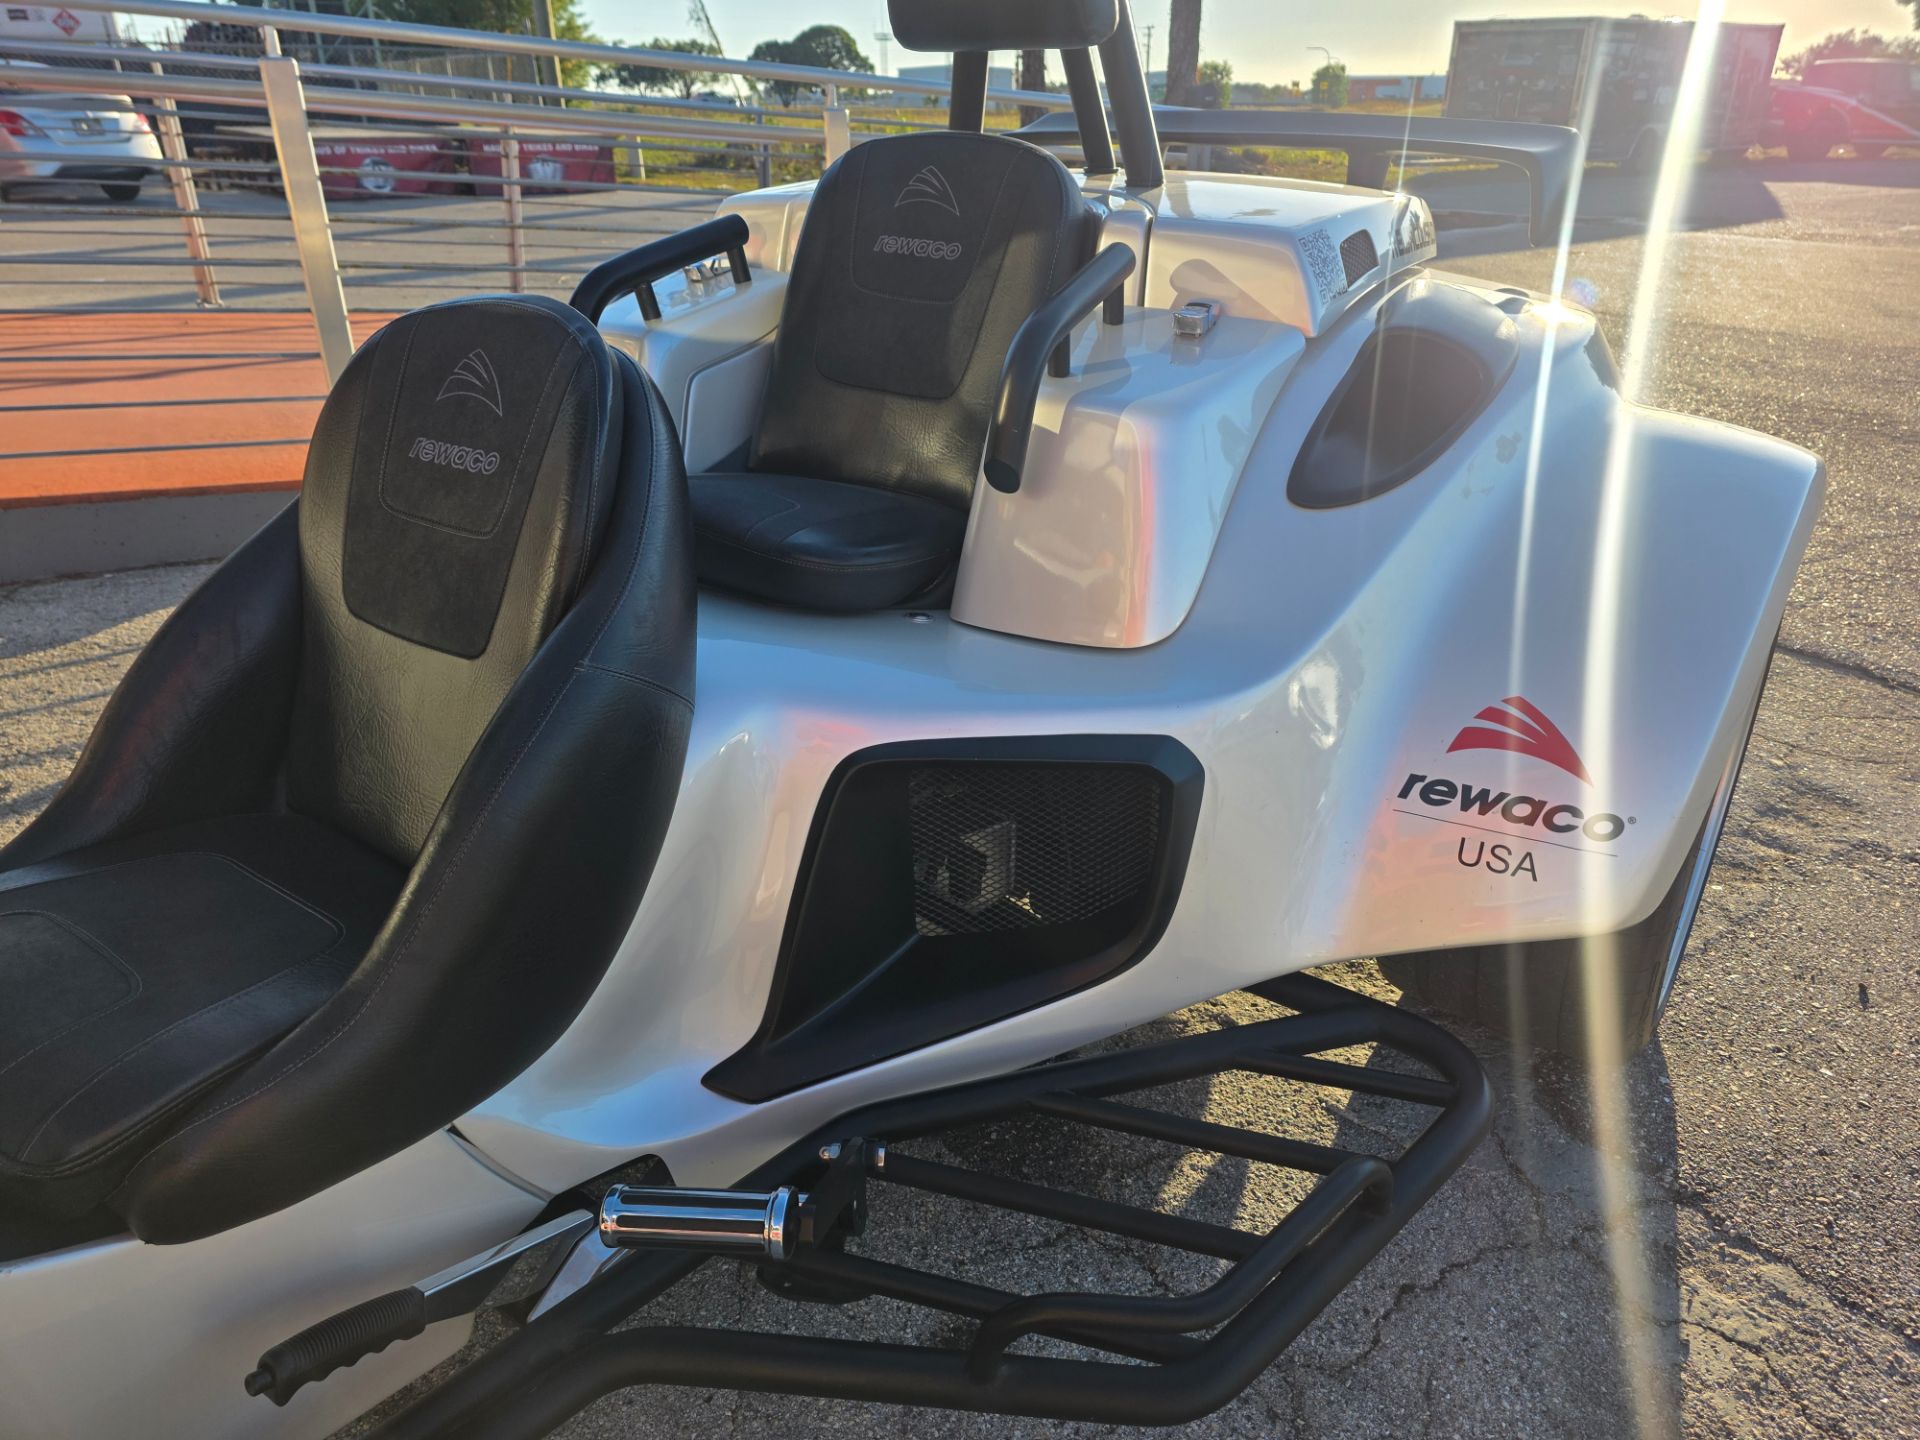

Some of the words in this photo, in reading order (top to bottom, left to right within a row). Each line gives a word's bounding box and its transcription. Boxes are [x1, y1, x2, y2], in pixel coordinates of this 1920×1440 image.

[873, 235, 961, 260] rewaco
[408, 437, 500, 475] rewaco
[1397, 773, 1625, 842] rewaco
[1457, 837, 1538, 882] USA
